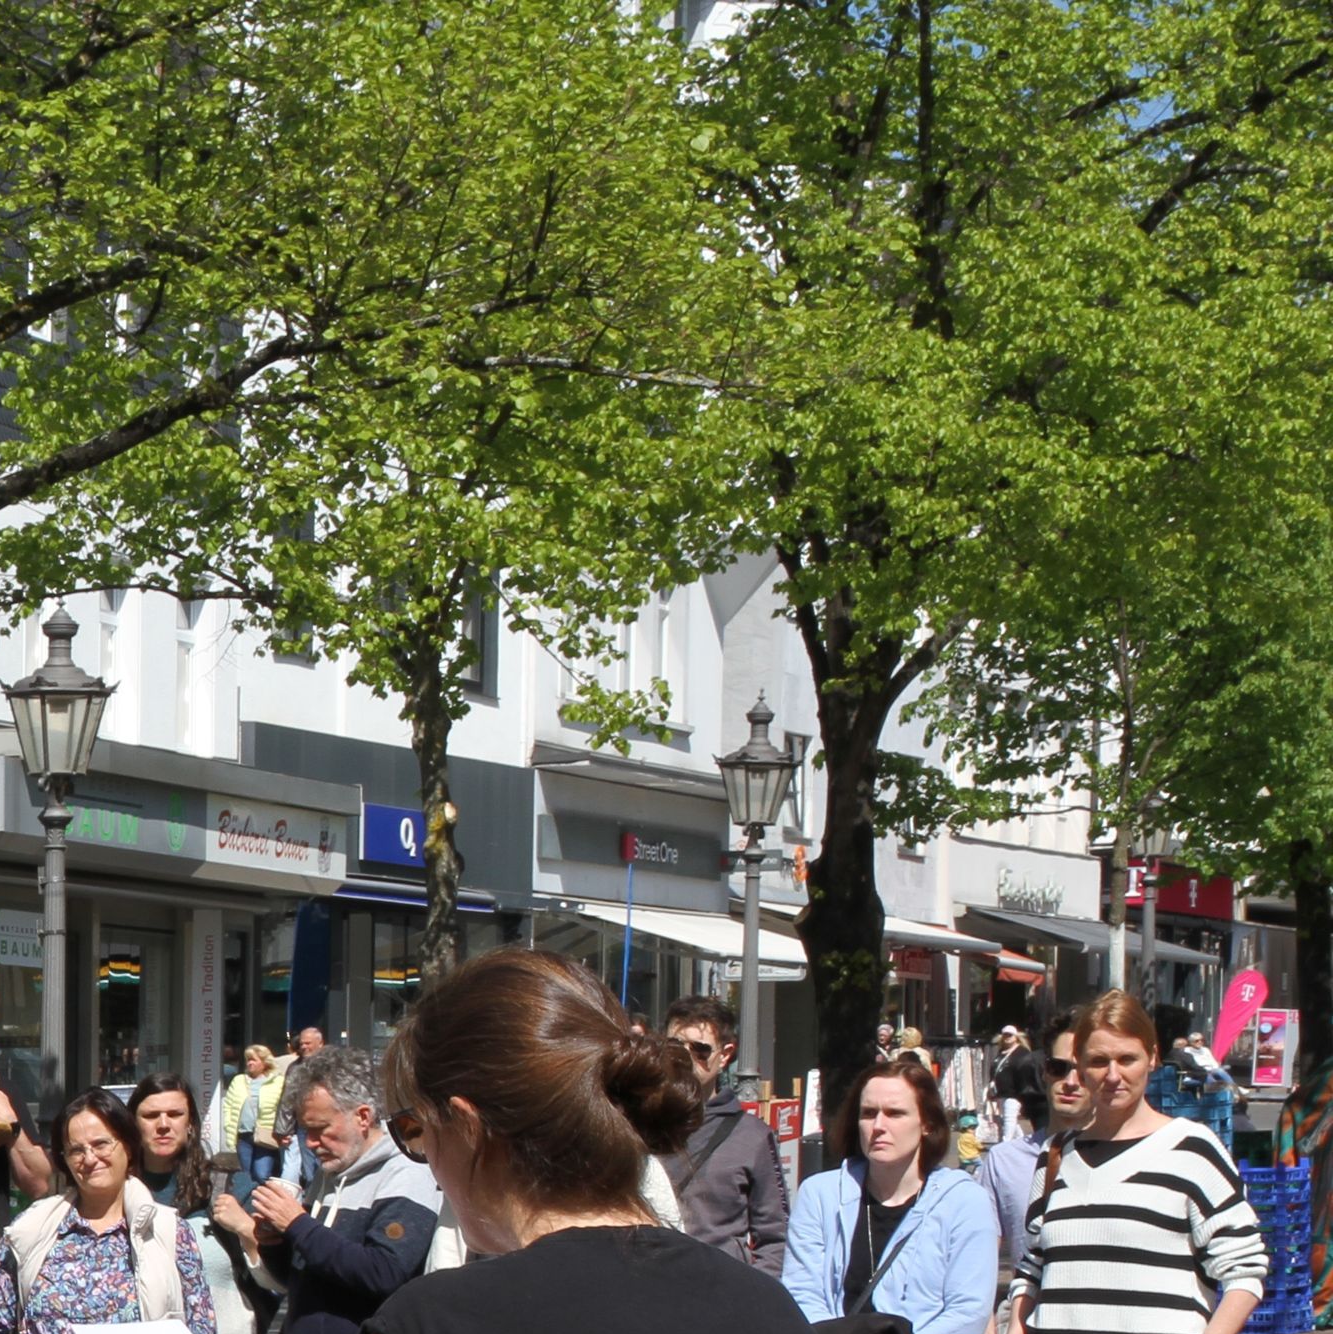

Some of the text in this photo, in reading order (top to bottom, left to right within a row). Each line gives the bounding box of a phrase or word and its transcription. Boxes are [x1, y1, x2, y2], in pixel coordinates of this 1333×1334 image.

[218, 809, 310, 862] Bäckerei Bauer
[201, 934, 214, 994] Tradition
[203, 1000, 213, 1023] aus
[201, 1028, 213, 1063] Haus
